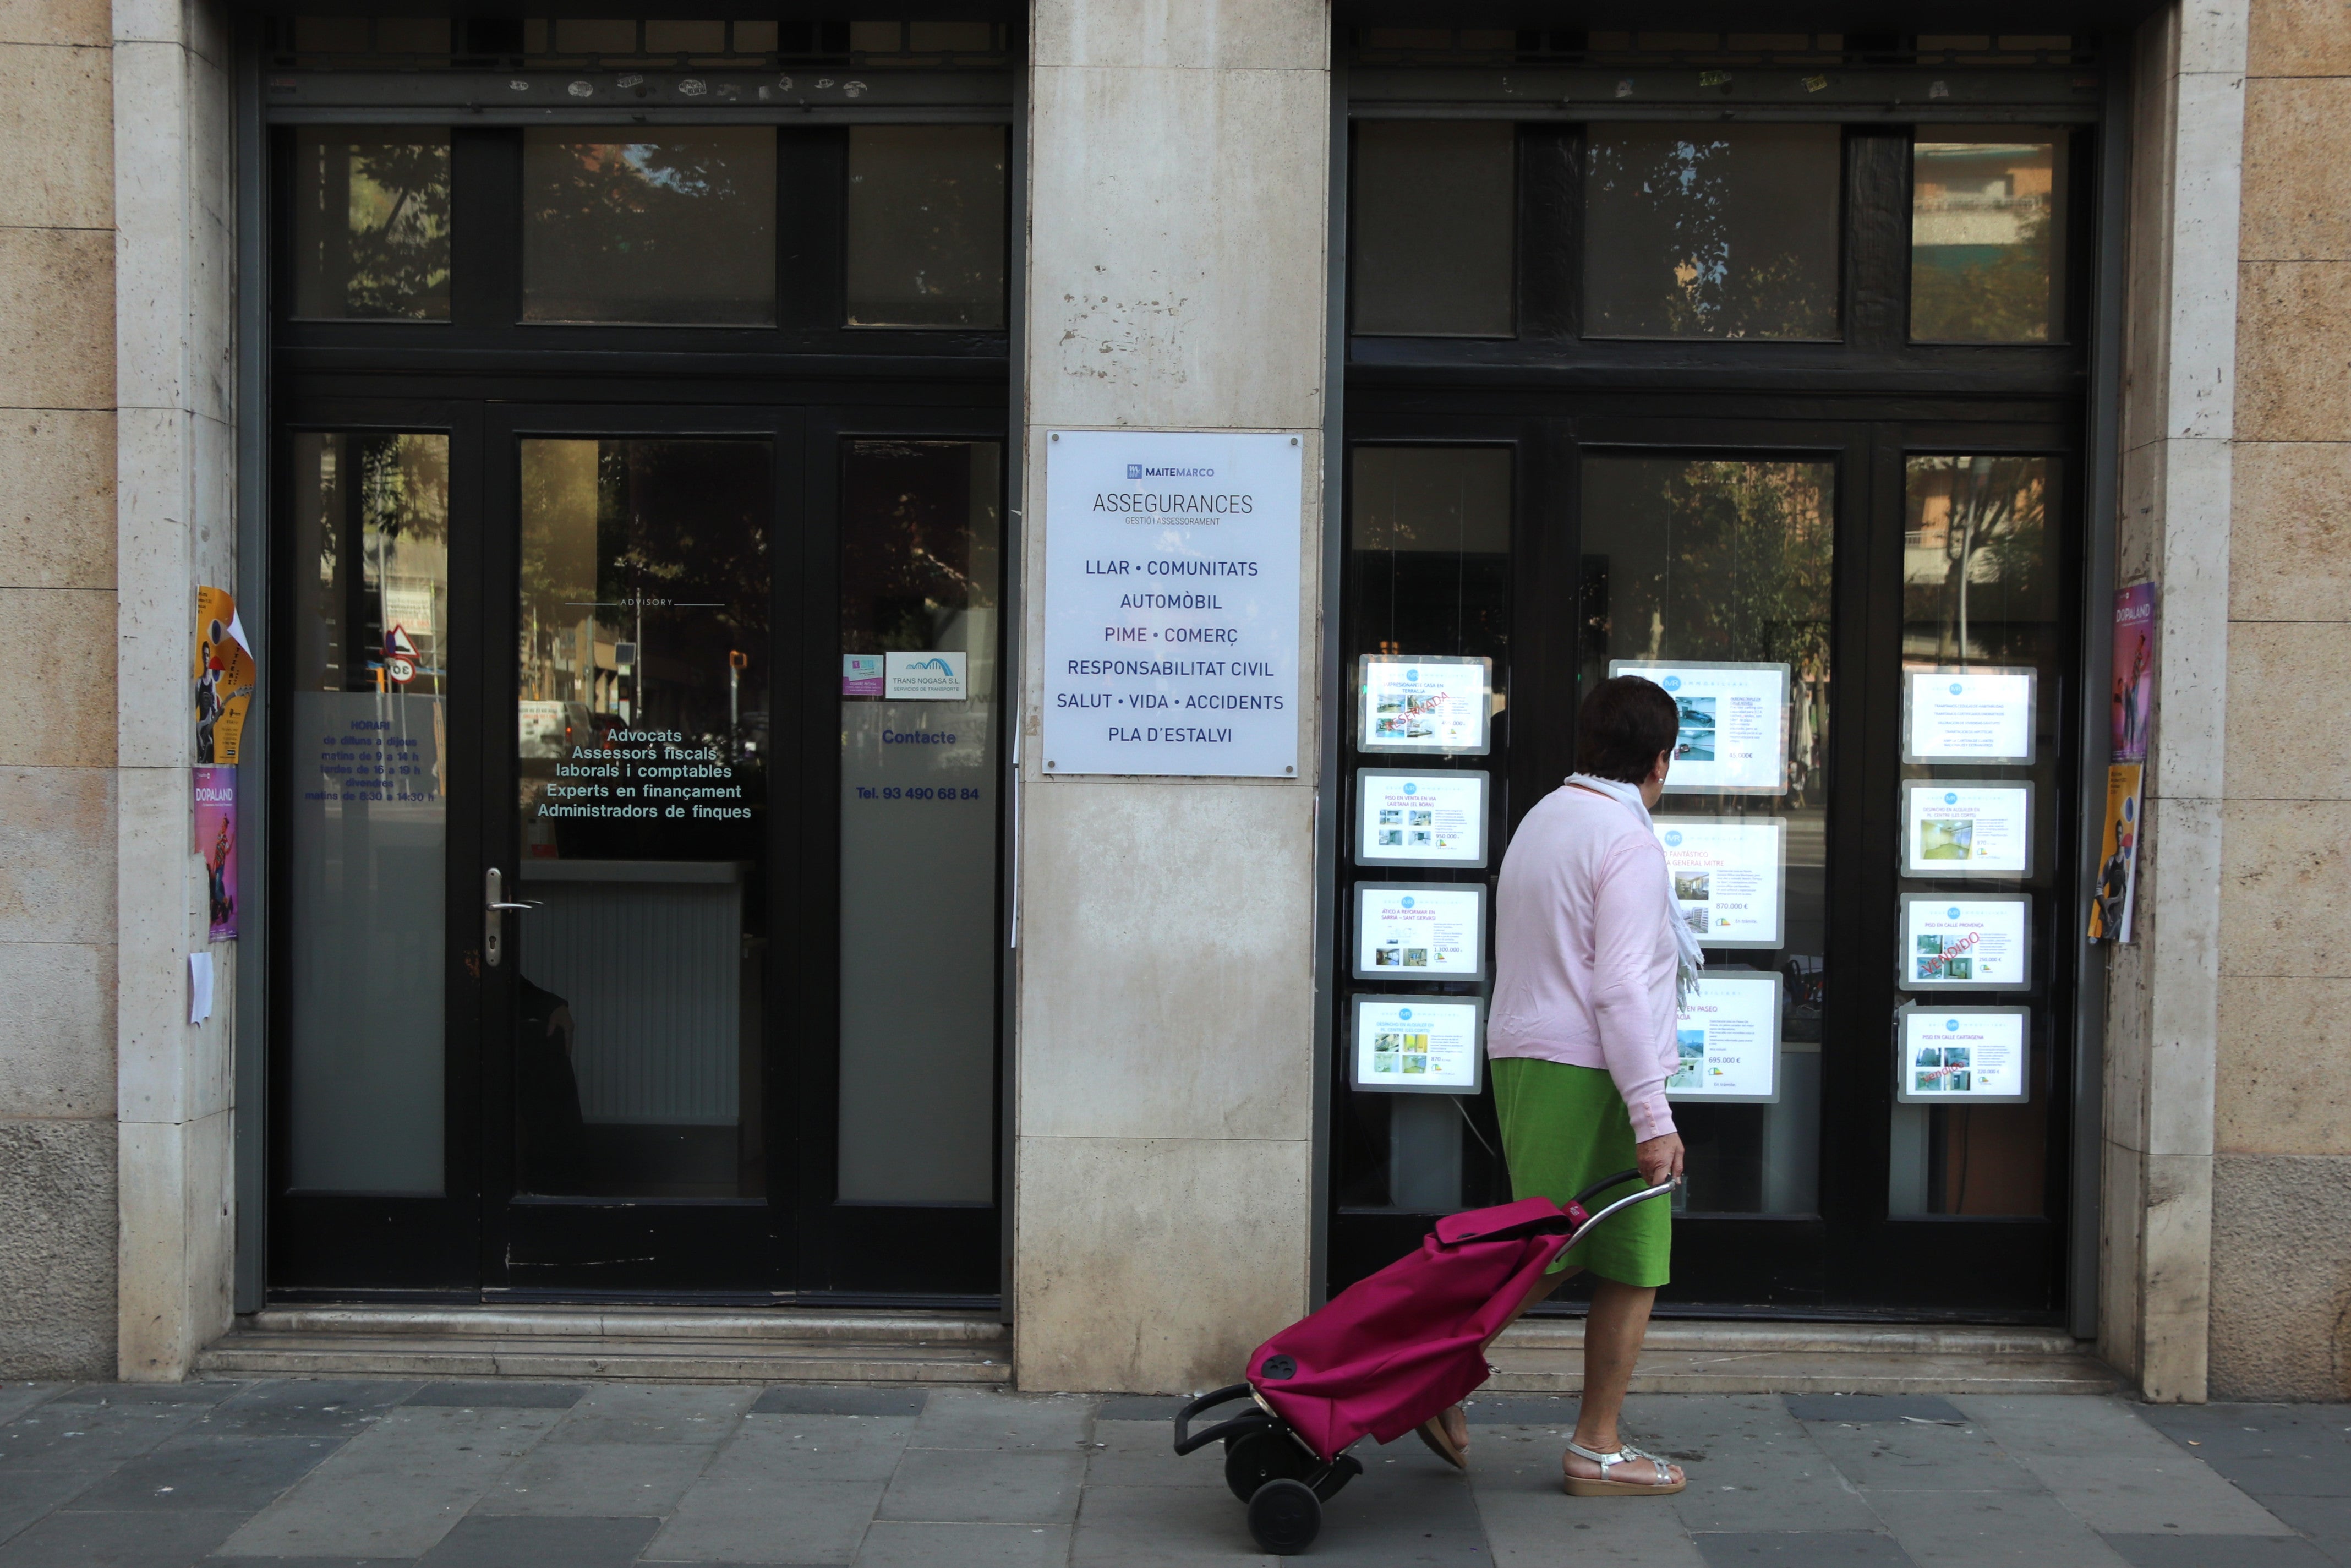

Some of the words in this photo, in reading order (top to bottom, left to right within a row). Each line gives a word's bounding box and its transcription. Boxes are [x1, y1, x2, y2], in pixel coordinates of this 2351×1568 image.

[1146, 467, 1214, 477] MAITEMARCO
[1092, 493, 1253, 513] ASSEGURANCES
[1125, 516, 1151, 525] GESTIÓ
[1157, 517, 1220, 525] ASSESSORAMENT
[1086, 560, 1129, 575] LLAR
[1147, 561, 1258, 576] COMUNITATS
[1120, 590, 1222, 609] AUTOMÒBIL
[2116, 603, 2150, 622] DOPALAND
[1105, 627, 1147, 642] PIME
[1164, 627, 1238, 646] COMERÇ
[1068, 660, 1226, 675] RESPONSABILITAT
[1231, 662, 1274, 676] CIVIL
[1057, 693, 1112, 708] SALUT
[1129, 694, 1169, 708] VIDA
[1185, 695, 1283, 710] ACCIDENTS
[1385, 691, 1450, 731] RESERVADA
[351, 720, 390, 730] HORARI
[323, 736, 336, 745] de
[340, 736, 372, 745] dilluns
[387, 736, 417, 747] dijous
[607, 729, 682, 742] Advocats
[882, 730, 956, 744] Contacte
[1109, 727, 1141, 741] PLA
[1147, 728, 1231, 742] D'ESTALVI
[321, 751, 354, 761] matins
[359, 751, 371, 761] de
[376, 752, 382, 761] 9
[397, 752, 408, 761] 14
[412, 752, 419, 761] h
[572, 746, 657, 760] Assessors
[665, 747, 717, 760] fiscals
[320, 765, 352, 774] tardes
[357, 765, 369, 774] de
[398, 765, 410, 774] 19
[414, 766, 420, 774] h
[556, 764, 619, 777] laborals
[626, 764, 631, 777] i
[638, 764, 732, 781] comptables
[346, 778, 393, 788] divendres
[196, 788, 233, 801] DOPALAND
[305, 791, 338, 800] matins
[342, 791, 355, 800] de
[359, 791, 382, 801] 8:30
[397, 792, 424, 801] 14:30
[428, 793, 434, 801] h
[546, 783, 609, 799] Experts
[616, 787, 636, 797] en
[643, 784, 741, 800] finançament
[856, 787, 878, 799] Tel.
[883, 787, 901, 799] 93
[905, 788, 933, 799] 490
[937, 788, 956, 799] 68
[960, 788, 979, 800] 84
[538, 803, 658, 817] Administradors
[665, 804, 685, 818] de
[692, 805, 751, 821] finques
[1669, 850, 1709, 858] FANTÁSTICO
[1922, 932, 1980, 974] VENDIDO
[1922, 1061, 1965, 1083] vendido
